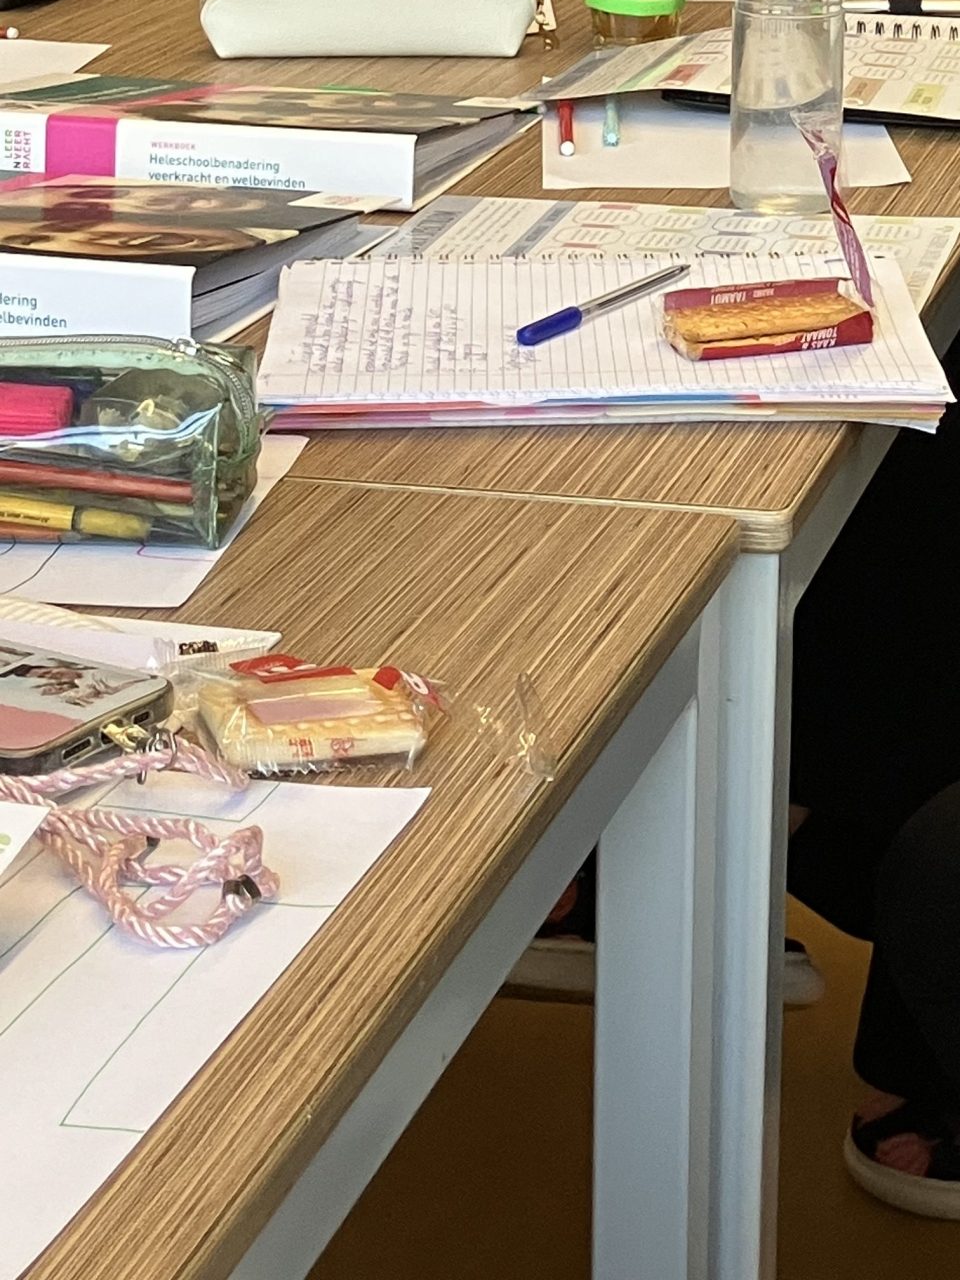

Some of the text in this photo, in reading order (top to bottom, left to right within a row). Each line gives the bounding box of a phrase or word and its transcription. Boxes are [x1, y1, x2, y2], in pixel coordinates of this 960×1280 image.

[22, 131, 31, 169] RACHT
[150, 154, 280, 174] Heleschoolbenadering
[149, 170, 306, 189] veerkracht en welbevinden
[801, 326, 838, 343] TOMAAT
